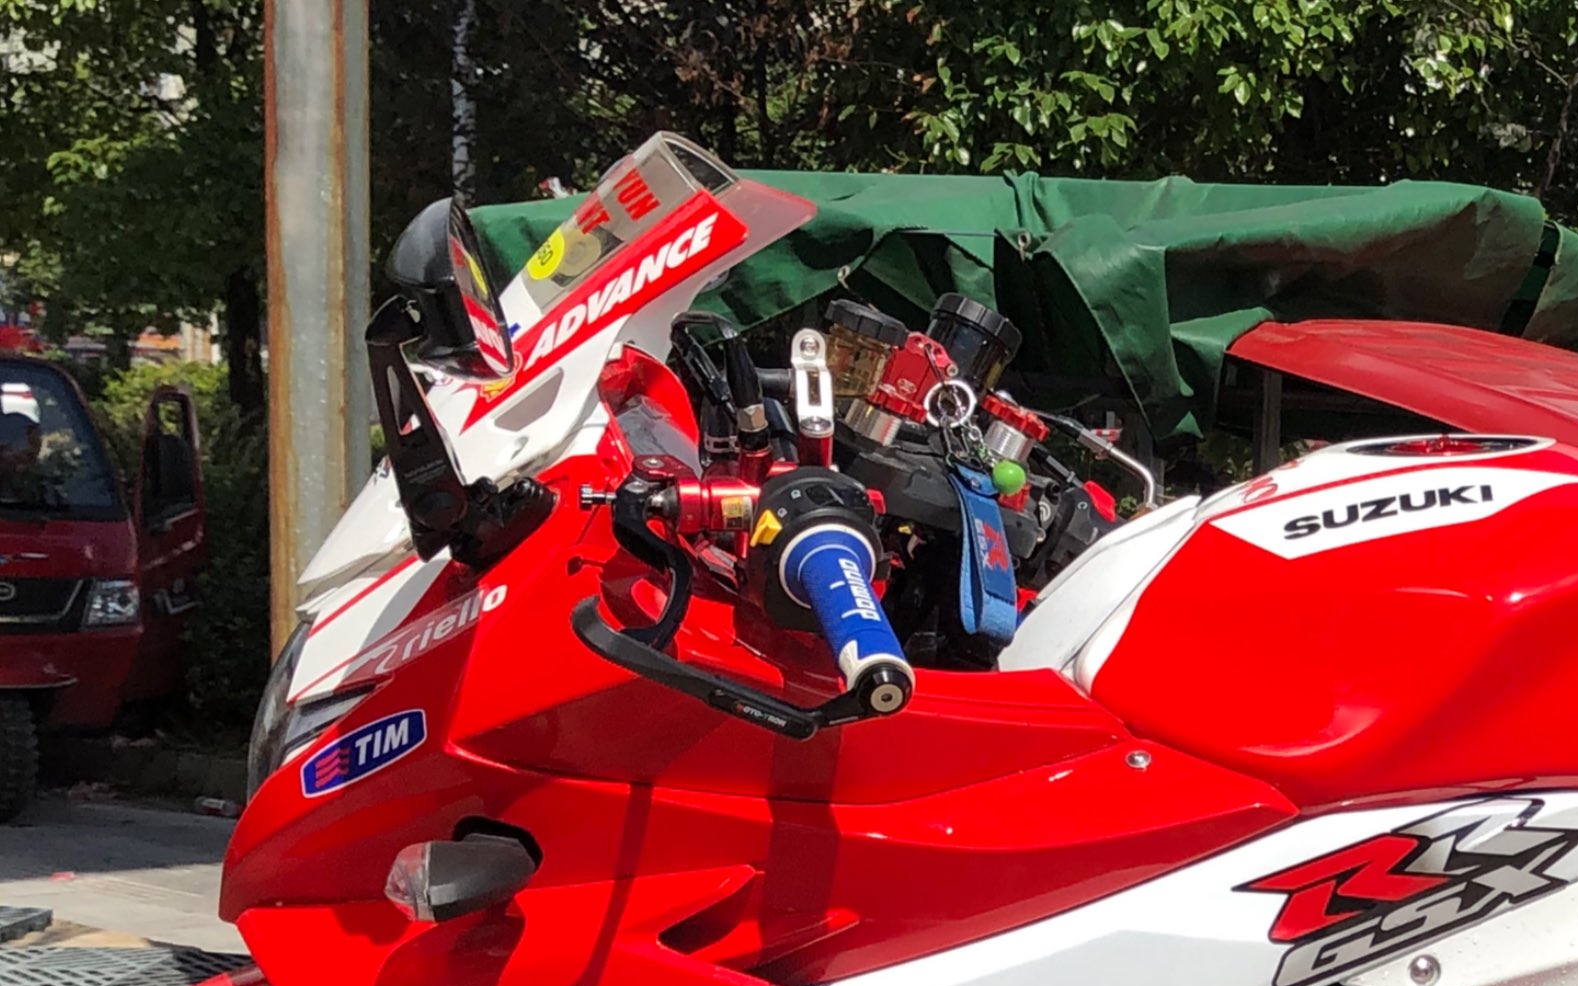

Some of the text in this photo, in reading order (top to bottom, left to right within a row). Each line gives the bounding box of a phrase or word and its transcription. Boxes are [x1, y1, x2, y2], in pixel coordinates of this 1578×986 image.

[523, 213, 719, 371] ADVANCE
[1284, 485, 1494, 540] SUZUKI
[829, 558, 882, 622] domino
[355, 717, 409, 767] TIM
